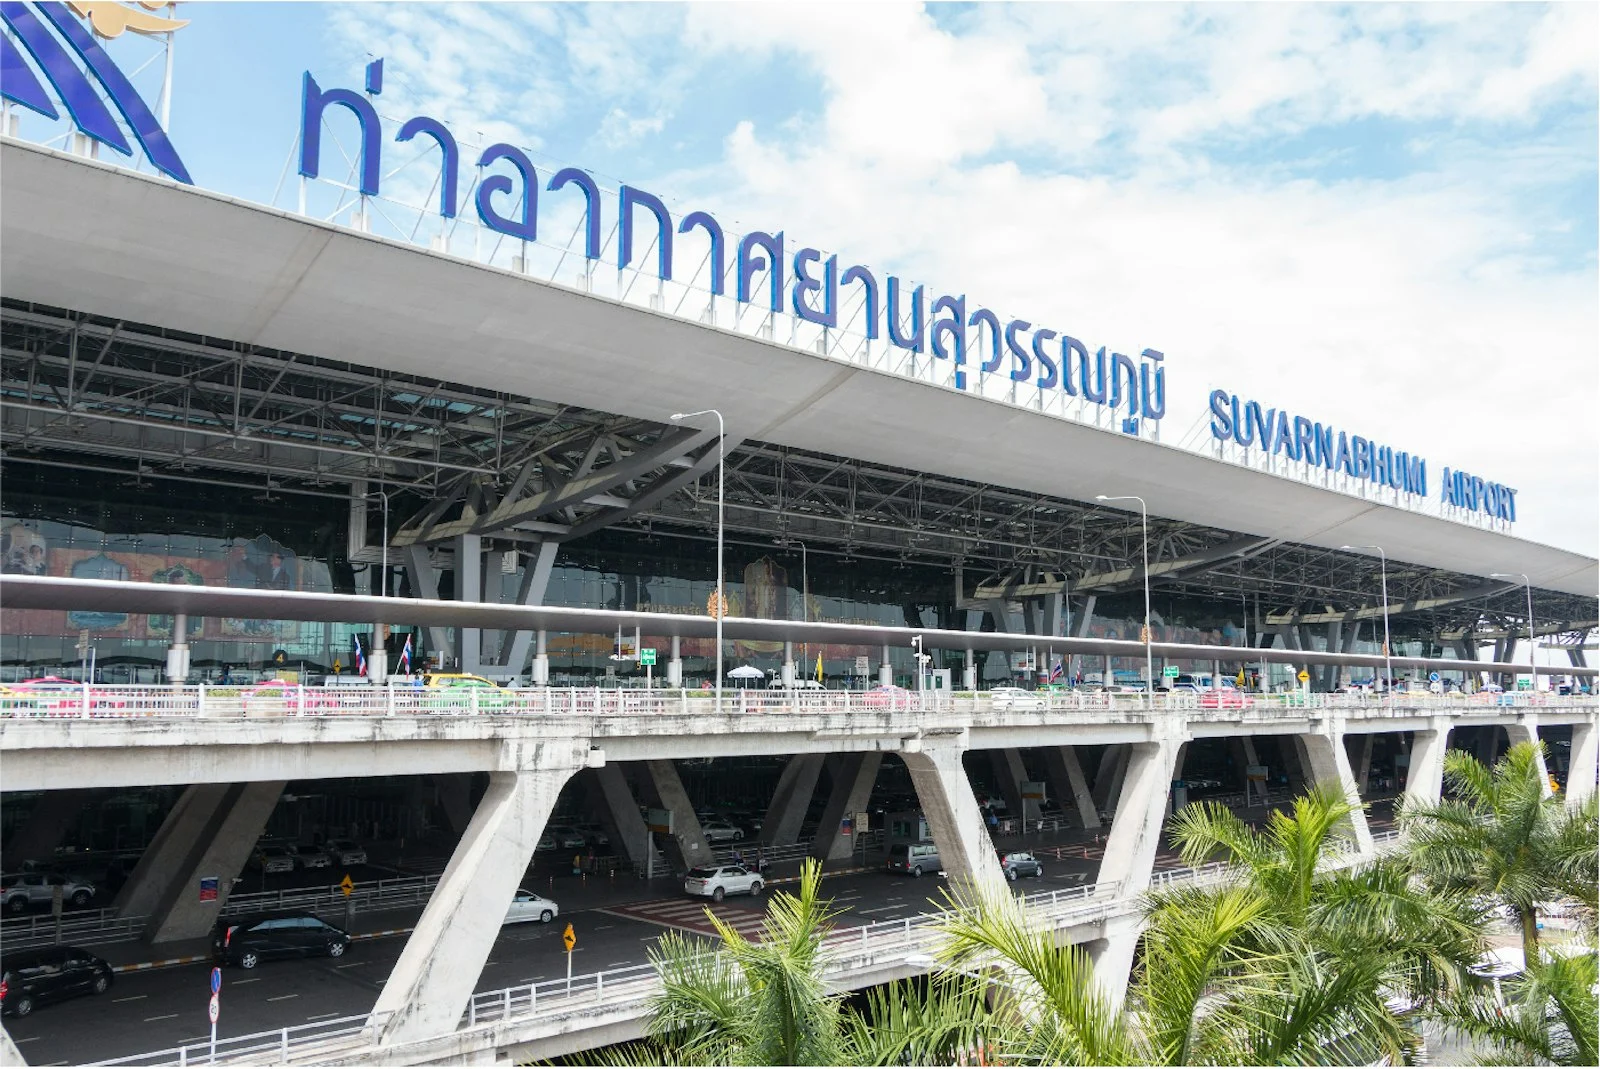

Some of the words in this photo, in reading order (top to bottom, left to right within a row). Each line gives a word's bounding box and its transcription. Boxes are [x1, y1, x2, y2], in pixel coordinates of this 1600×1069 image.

[298, 57, 1165, 436] ท่าอากาศยานสุวรรณภูมิ
[1209, 389, 1427, 497] SUVARNABHUMI
[1441, 466, 1518, 522] AIRPORT
